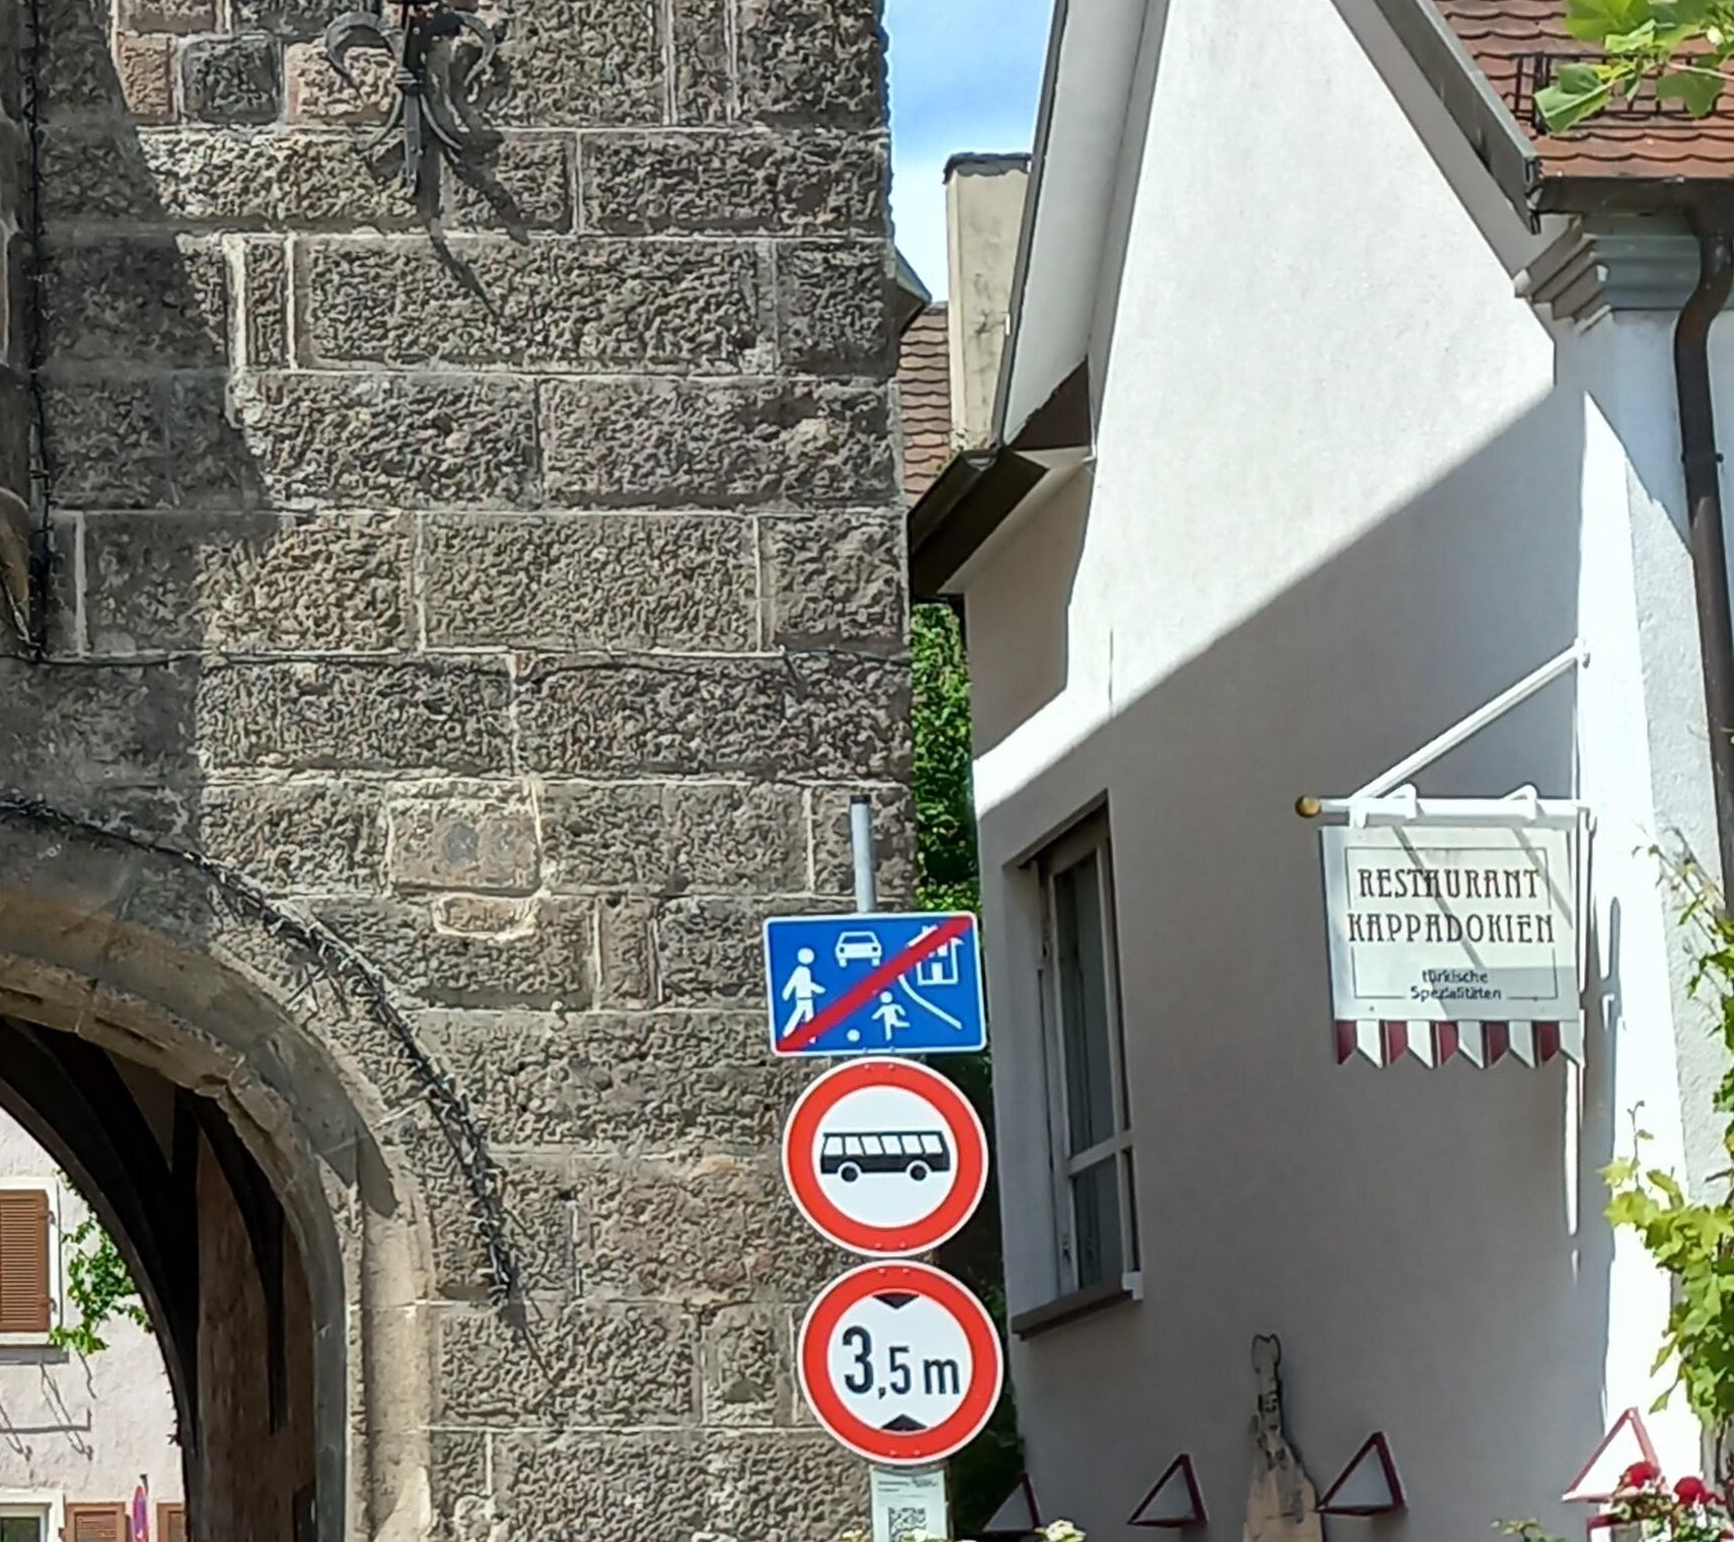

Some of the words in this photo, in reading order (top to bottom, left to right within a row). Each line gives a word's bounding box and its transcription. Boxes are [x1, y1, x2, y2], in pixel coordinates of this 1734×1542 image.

[1358, 868, 1540, 899] RESTAURANT
[1348, 913, 1555, 944] KAPPADOKIEN
[842, 1325, 912, 1399] 3,5
[923, 1359, 960, 1395] m
